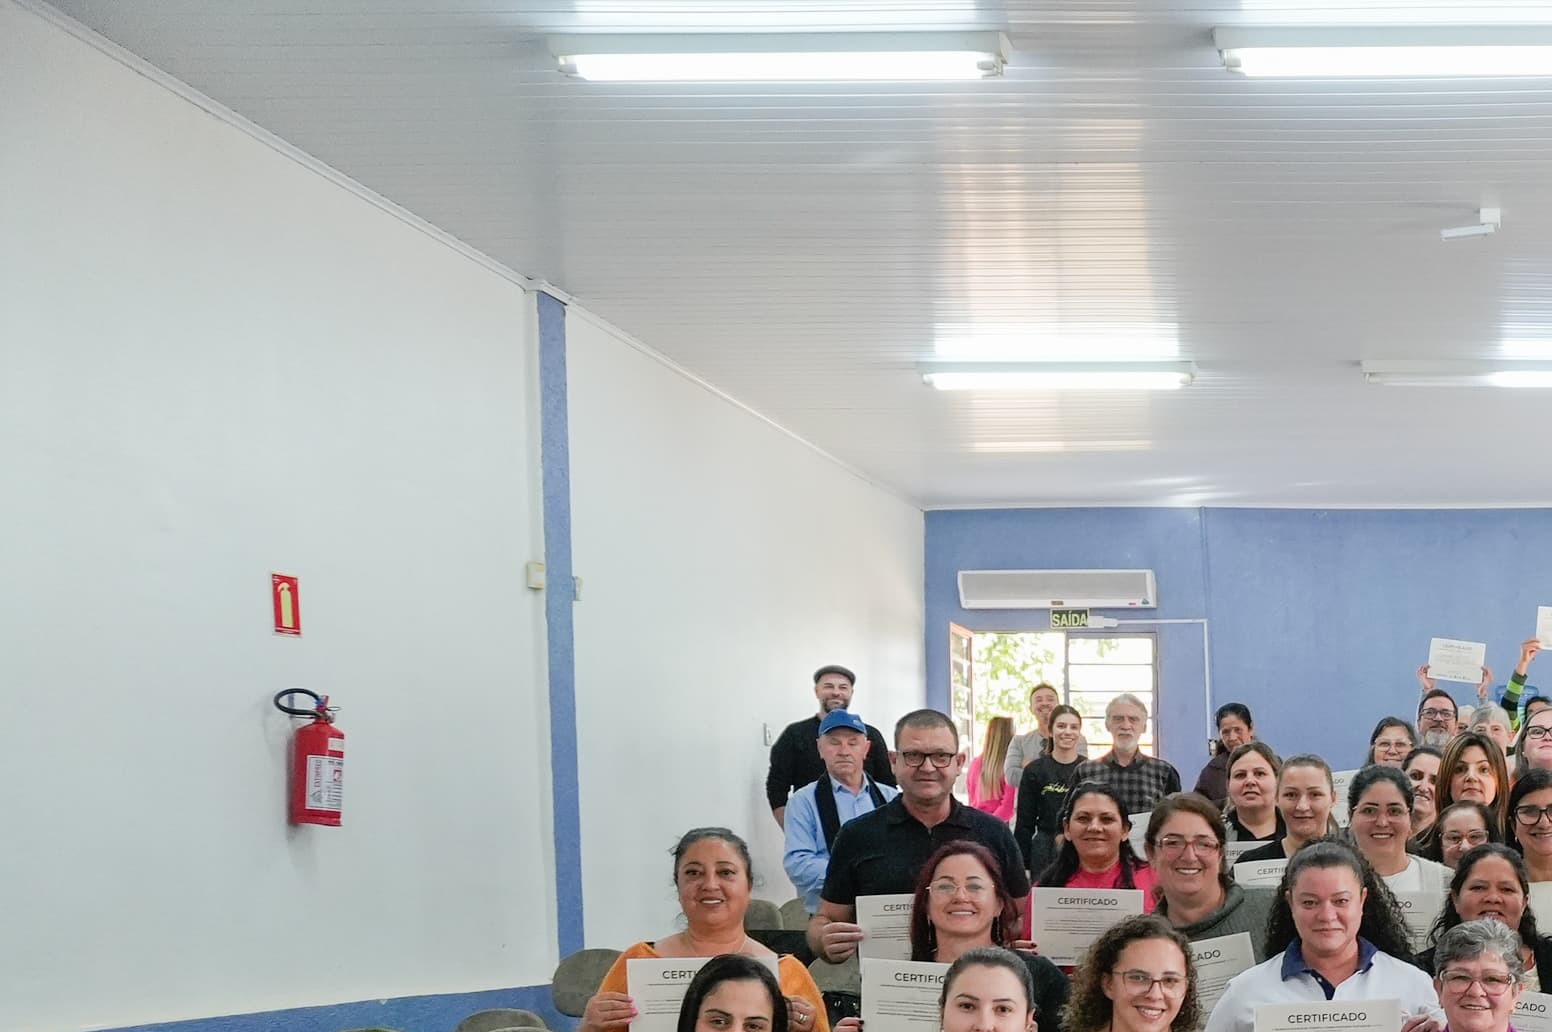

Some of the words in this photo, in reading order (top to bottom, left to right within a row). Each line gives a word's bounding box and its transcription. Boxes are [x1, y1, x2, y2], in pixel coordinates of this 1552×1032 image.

[1052, 610, 1088, 626] SAÍDA
[1057, 897, 1118, 906] CERTIFICADO
[894, 972, 945, 984] CERTIFIC
[1287, 1012, 1367, 1024] CERTIFICADO
